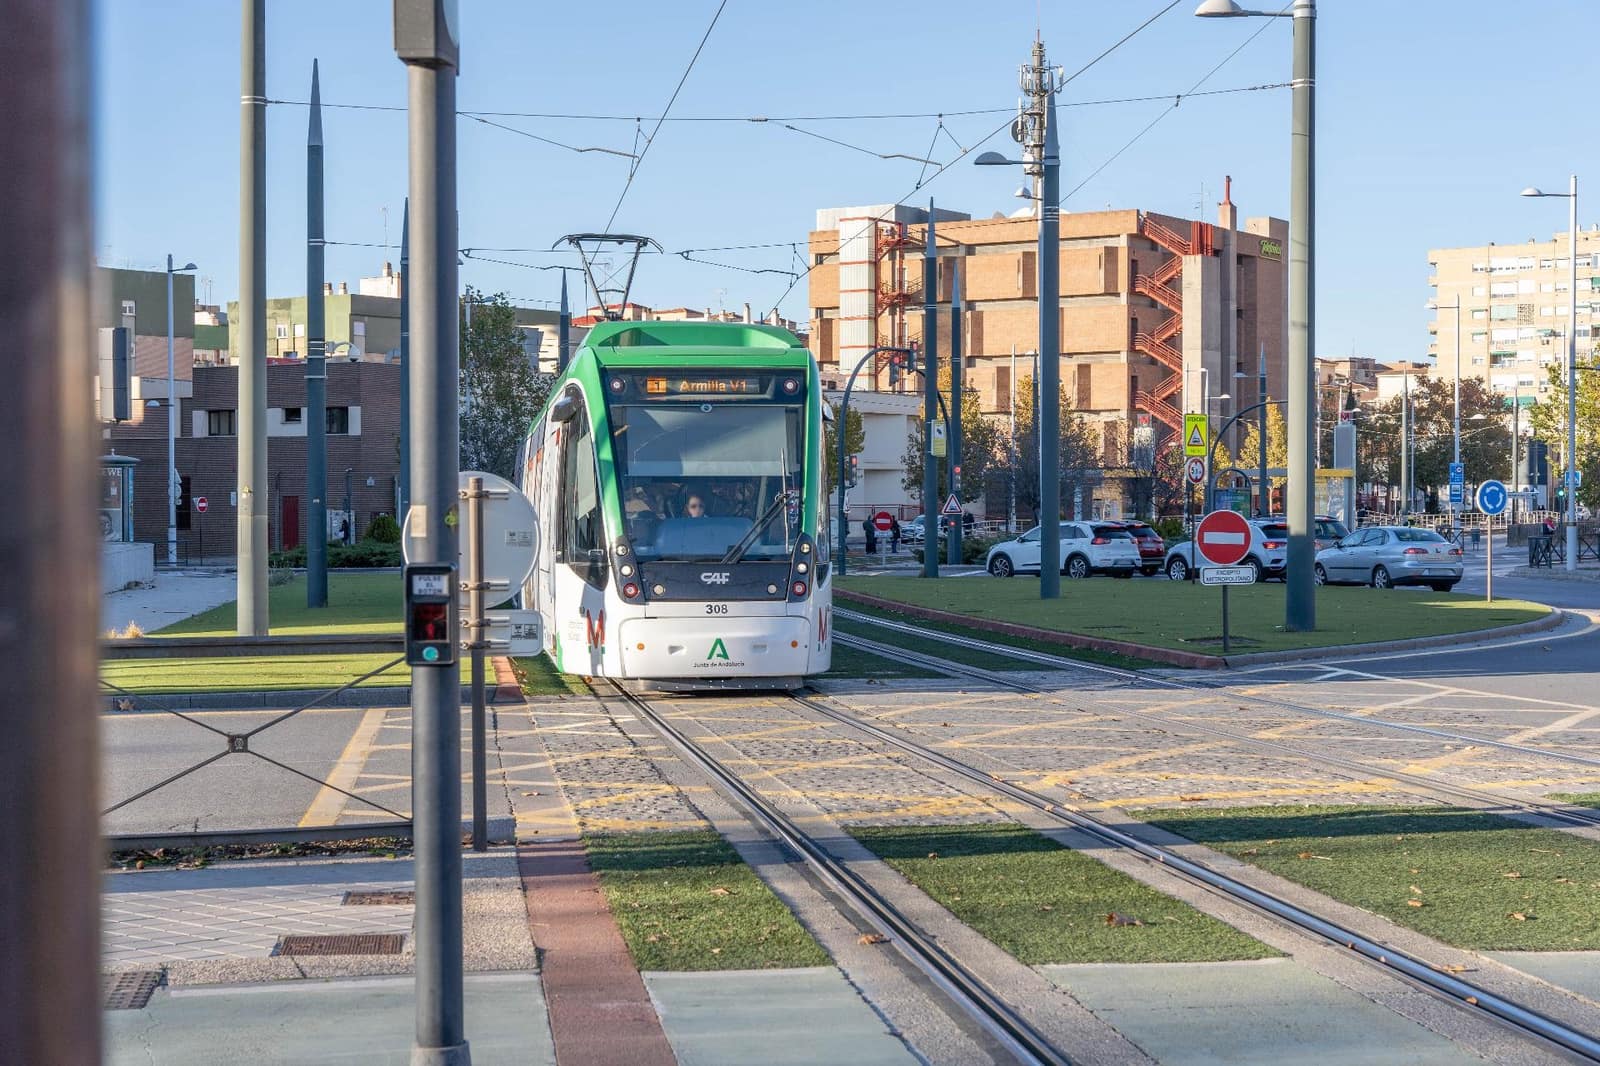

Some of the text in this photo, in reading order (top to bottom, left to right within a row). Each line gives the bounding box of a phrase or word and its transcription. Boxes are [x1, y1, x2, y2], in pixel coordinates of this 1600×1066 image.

[680, 380, 726, 392] Armilla
[730, 380, 747, 392] V1
[701, 573, 730, 584] CAF
[706, 604, 728, 614] 308
